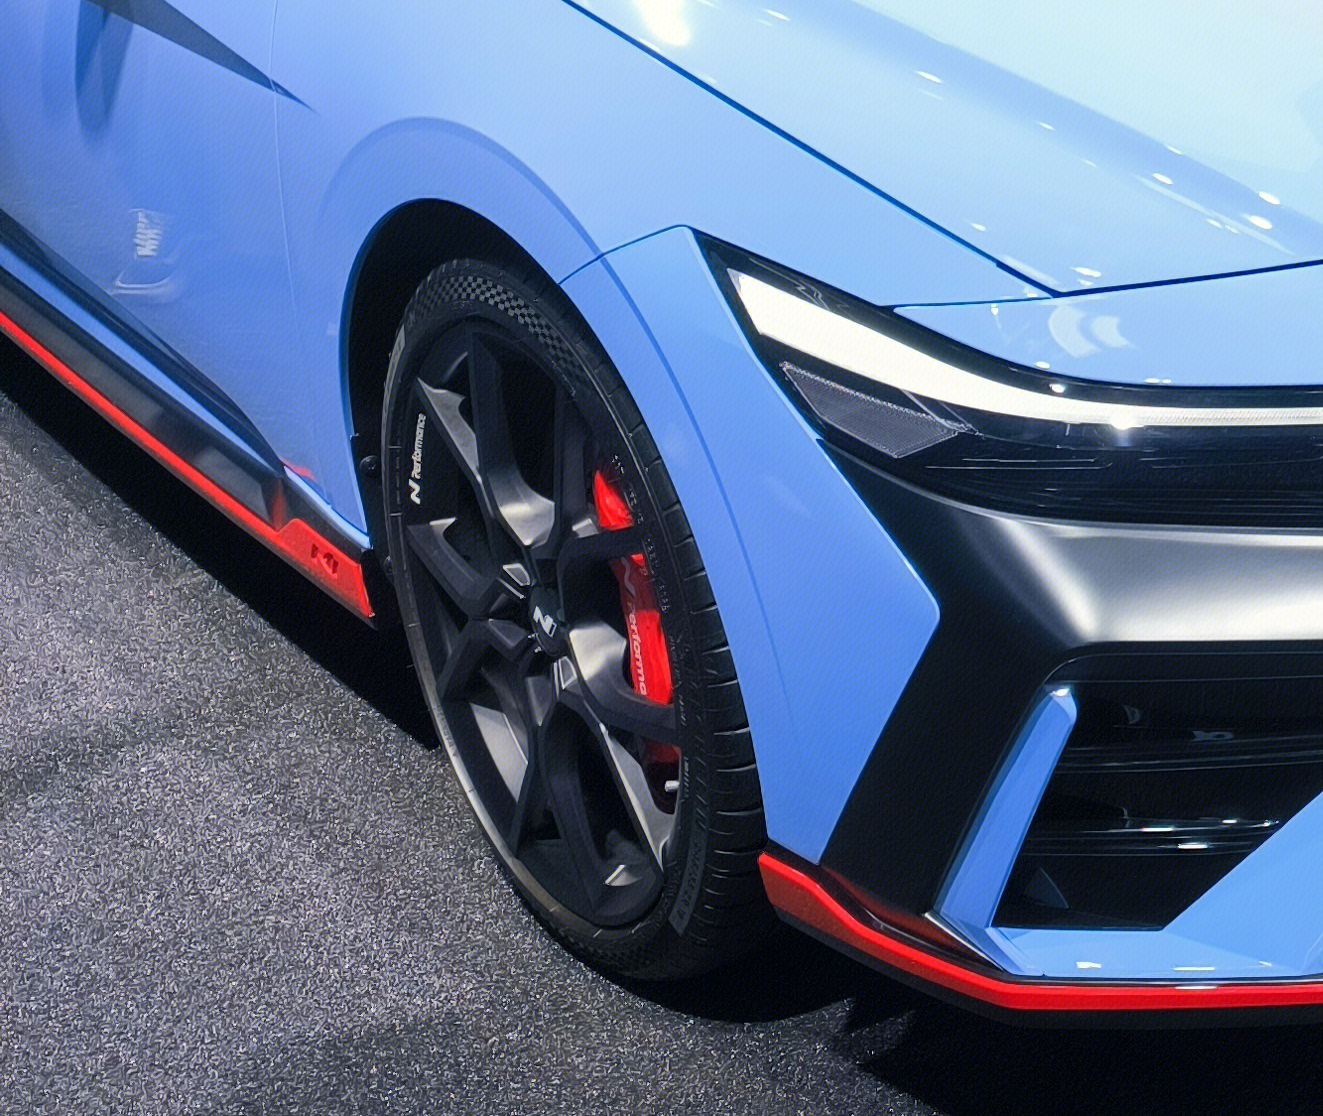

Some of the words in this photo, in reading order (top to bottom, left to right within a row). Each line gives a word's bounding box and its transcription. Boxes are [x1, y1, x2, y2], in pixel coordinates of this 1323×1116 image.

[411, 412, 426, 480] Performance
[408, 478, 421, 505] N
[627, 601, 647, 696] Performa
